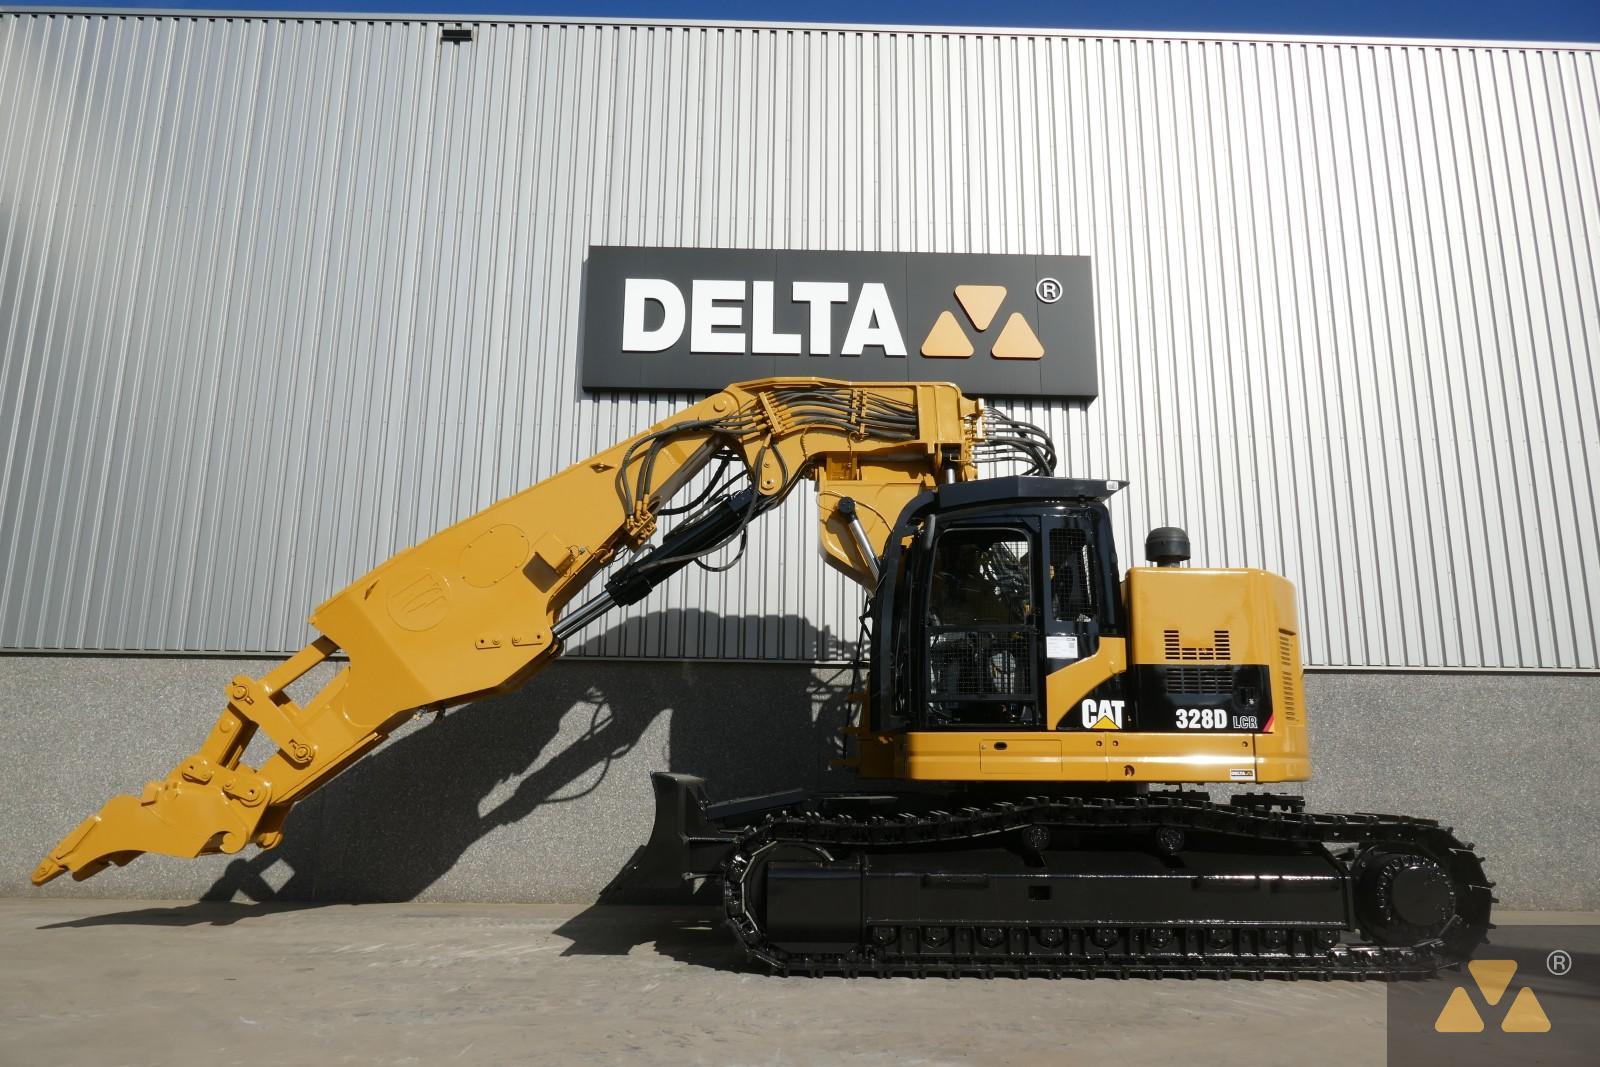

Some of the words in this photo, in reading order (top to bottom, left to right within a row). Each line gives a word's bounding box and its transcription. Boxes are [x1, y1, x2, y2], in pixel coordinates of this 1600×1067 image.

[622, 278, 908, 356] DELTA
[1081, 699, 1125, 729] CAT
[1175, 709, 1228, 729] 328D
[1233, 716, 1258, 729] LCR
